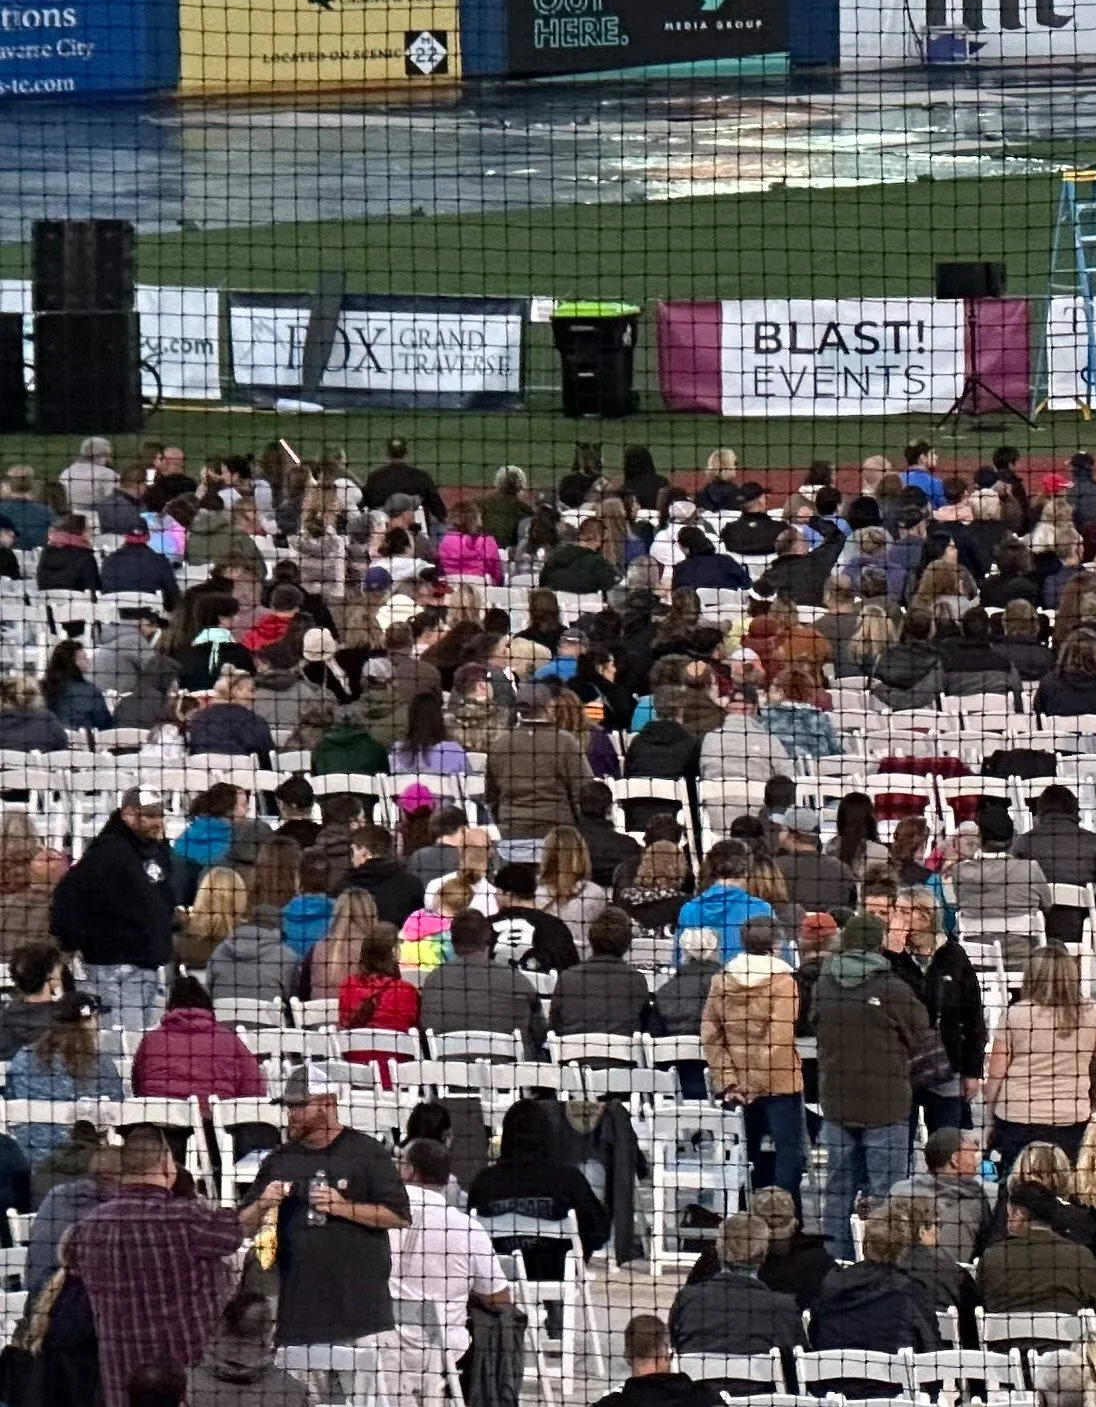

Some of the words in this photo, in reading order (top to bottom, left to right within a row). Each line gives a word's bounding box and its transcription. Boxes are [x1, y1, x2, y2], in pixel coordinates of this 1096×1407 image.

[534, 16, 630, 49] HERE.
[664, 21, 708, 31] MEDIA
[716, 19, 763, 30] GROUP
[56, 38, 95, 60] City
[415, 47, 438, 63] 22
[400, 328, 486, 351] GRAND
[754, 320, 925, 355] BLAST!
[400, 353, 512, 377] TRAVERSE
[754, 365, 927, 398] EVENTS
